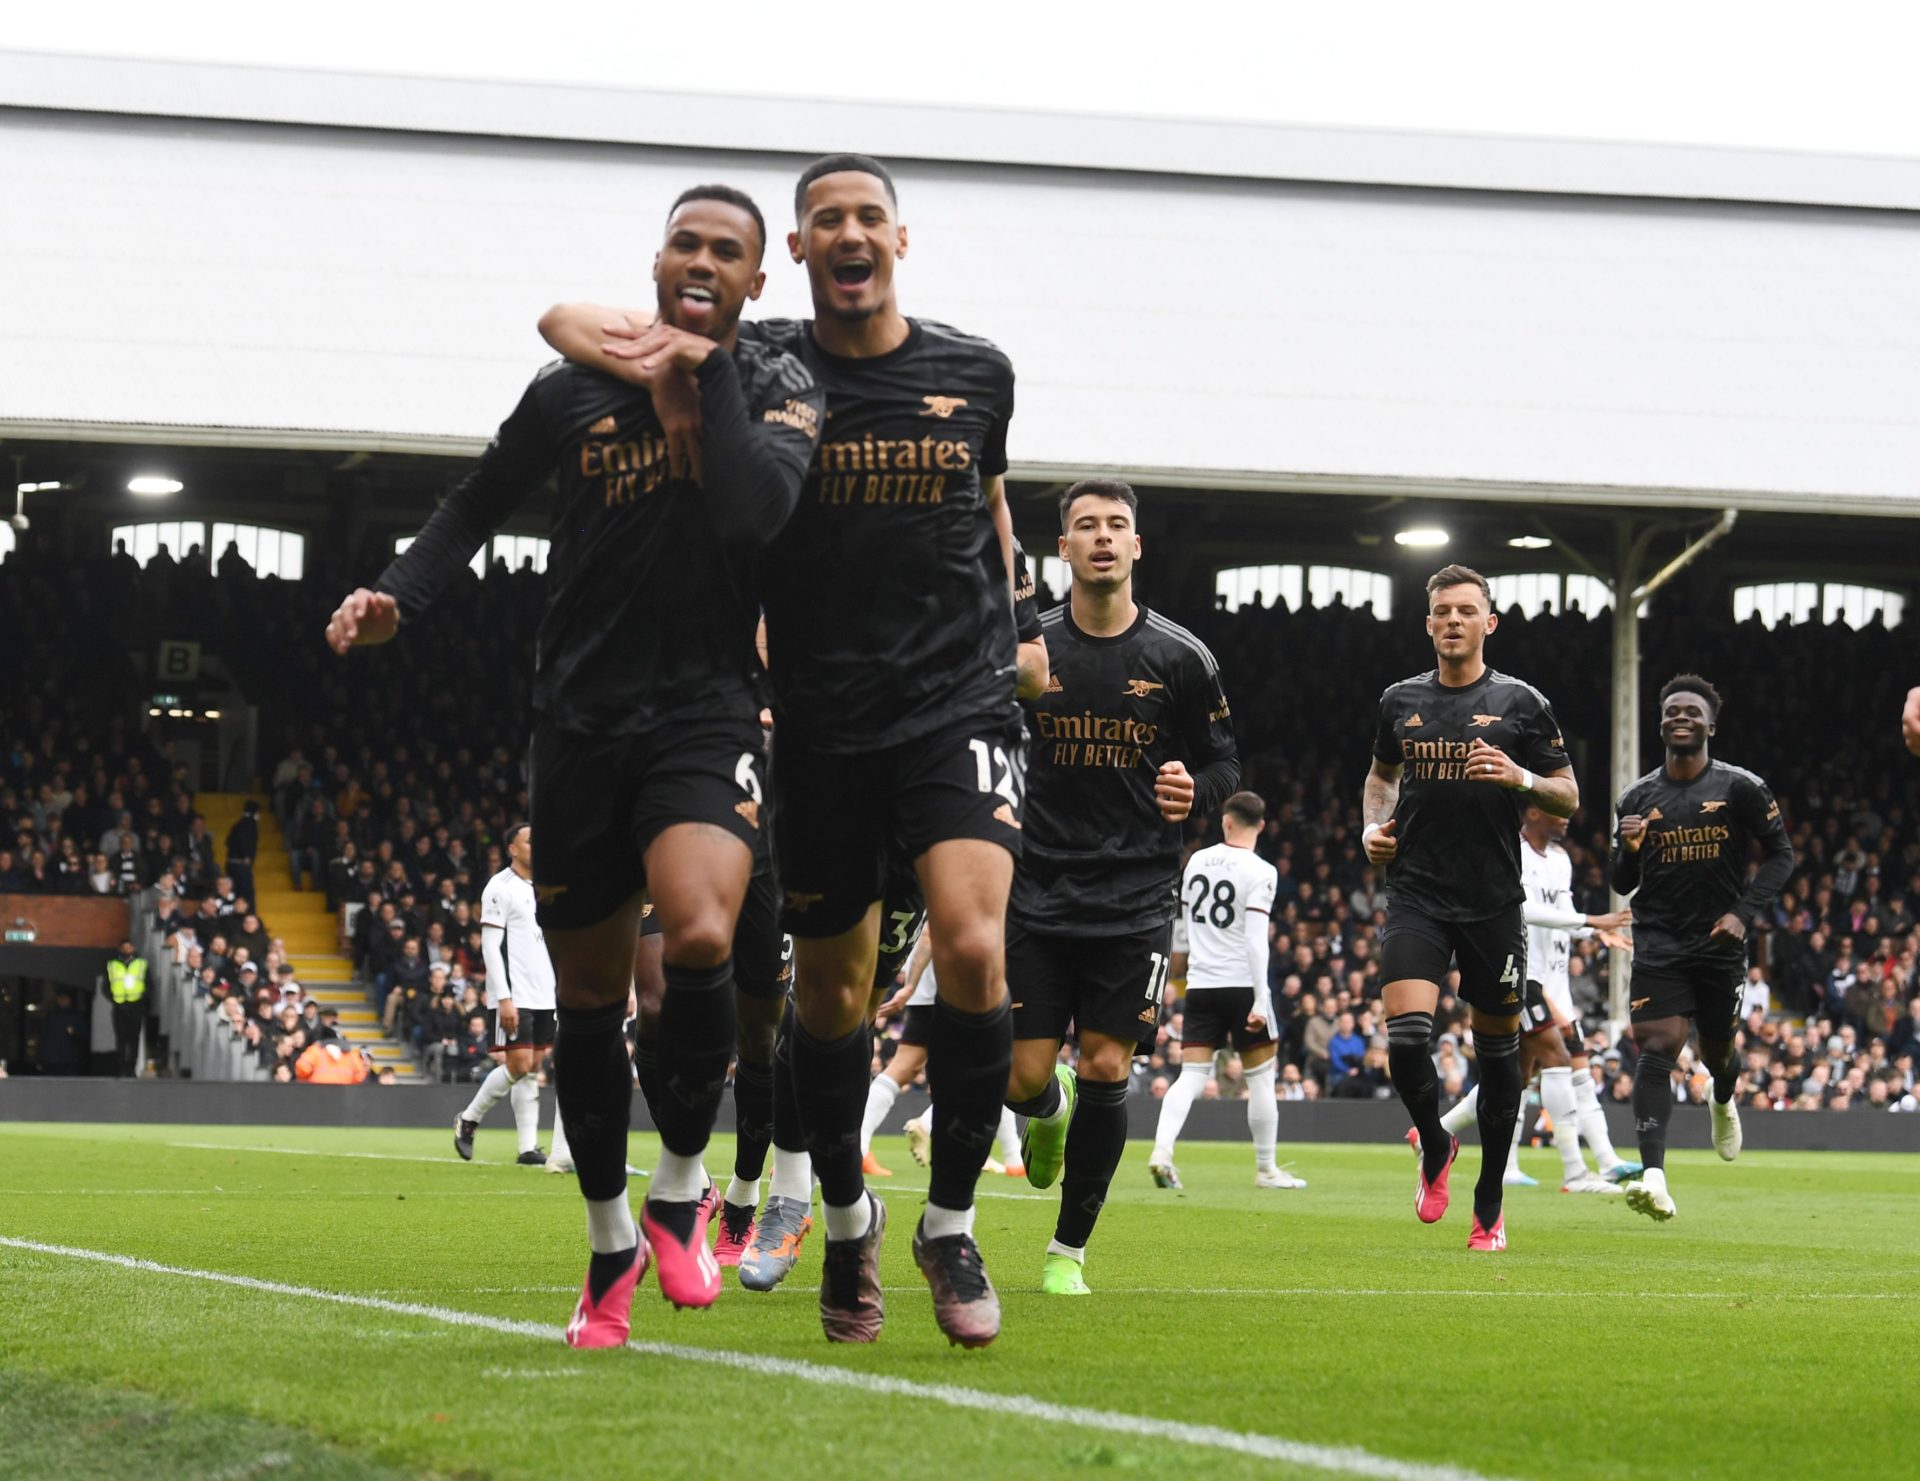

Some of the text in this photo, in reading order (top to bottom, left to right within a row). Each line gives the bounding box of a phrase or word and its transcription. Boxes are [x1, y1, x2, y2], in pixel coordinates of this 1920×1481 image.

[820, 432, 971, 470] mirates
[819, 474, 946, 504] FLY BETTER
[166, 647, 190, 674] B
[1036, 709, 1158, 745] Emirates
[969, 738, 1018, 808] 12
[1053, 743, 1142, 769] FLY BETTER
[1416, 762, 1433, 780] FLY
[735, 752, 762, 805] 6
[1648, 825, 1729, 847] Emirates
[1661, 843, 1720, 864] FLY BETTER
[1188, 874, 1235, 929] 28
[1145, 952, 1168, 1005] 11
[1499, 954, 1519, 988] 4
